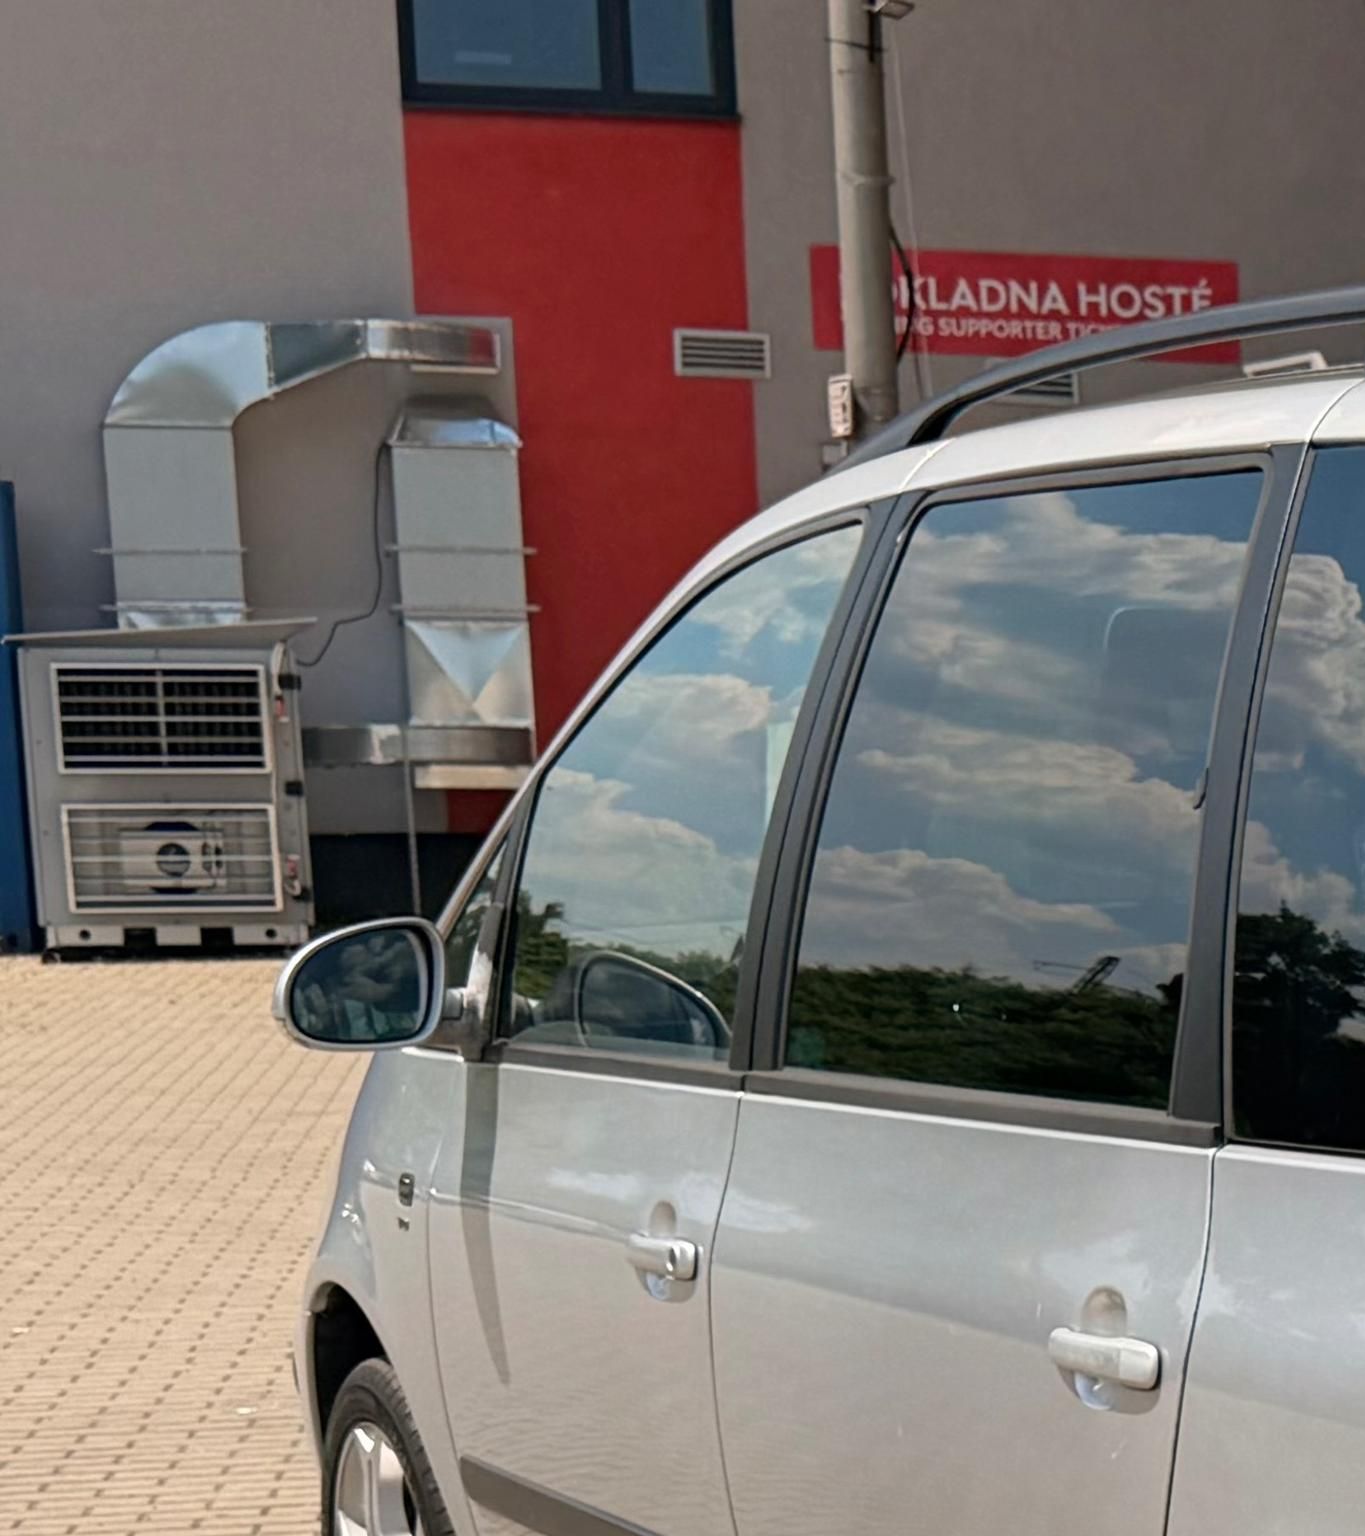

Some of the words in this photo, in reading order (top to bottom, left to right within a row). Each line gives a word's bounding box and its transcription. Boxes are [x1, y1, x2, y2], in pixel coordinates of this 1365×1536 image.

[892, 275, 1070, 314] KLADNA
[1077, 278, 1213, 319] HOSTÉ
[938, 316, 1063, 340] SUPPORTER
